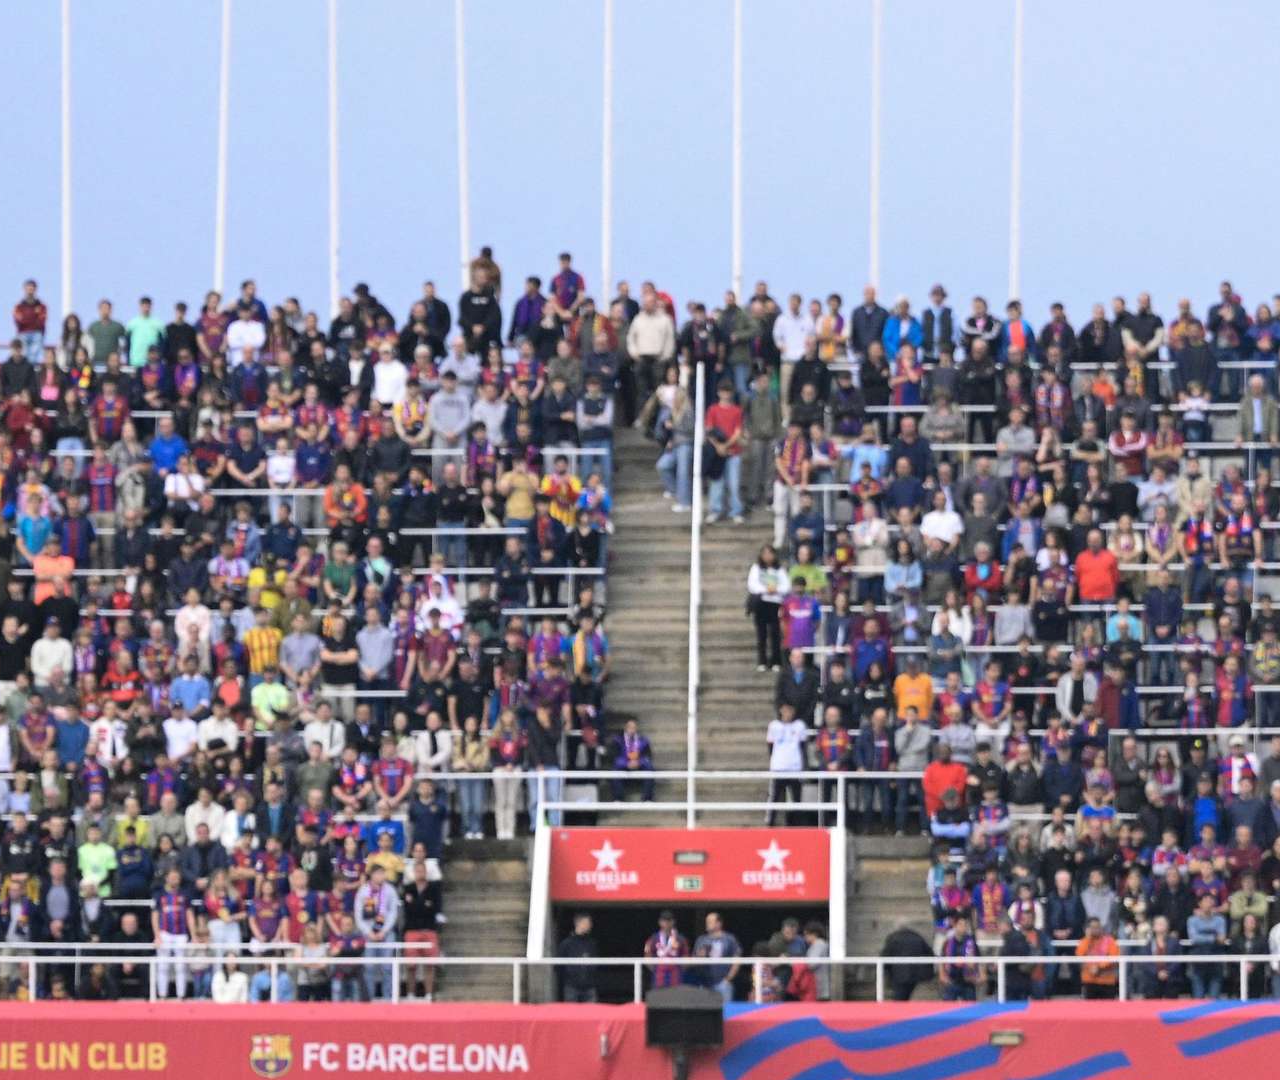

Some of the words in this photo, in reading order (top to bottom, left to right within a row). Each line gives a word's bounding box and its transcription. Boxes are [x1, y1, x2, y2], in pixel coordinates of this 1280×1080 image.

[577, 871, 638, 884] ESTRELLA
[743, 871, 804, 884] ESTRELLA
[36, 1041, 79, 1070] UN
[87, 1041, 168, 1070] CLUB
[303, 1043, 340, 1072] FC
[347, 1043, 530, 1072] BARCELONA
